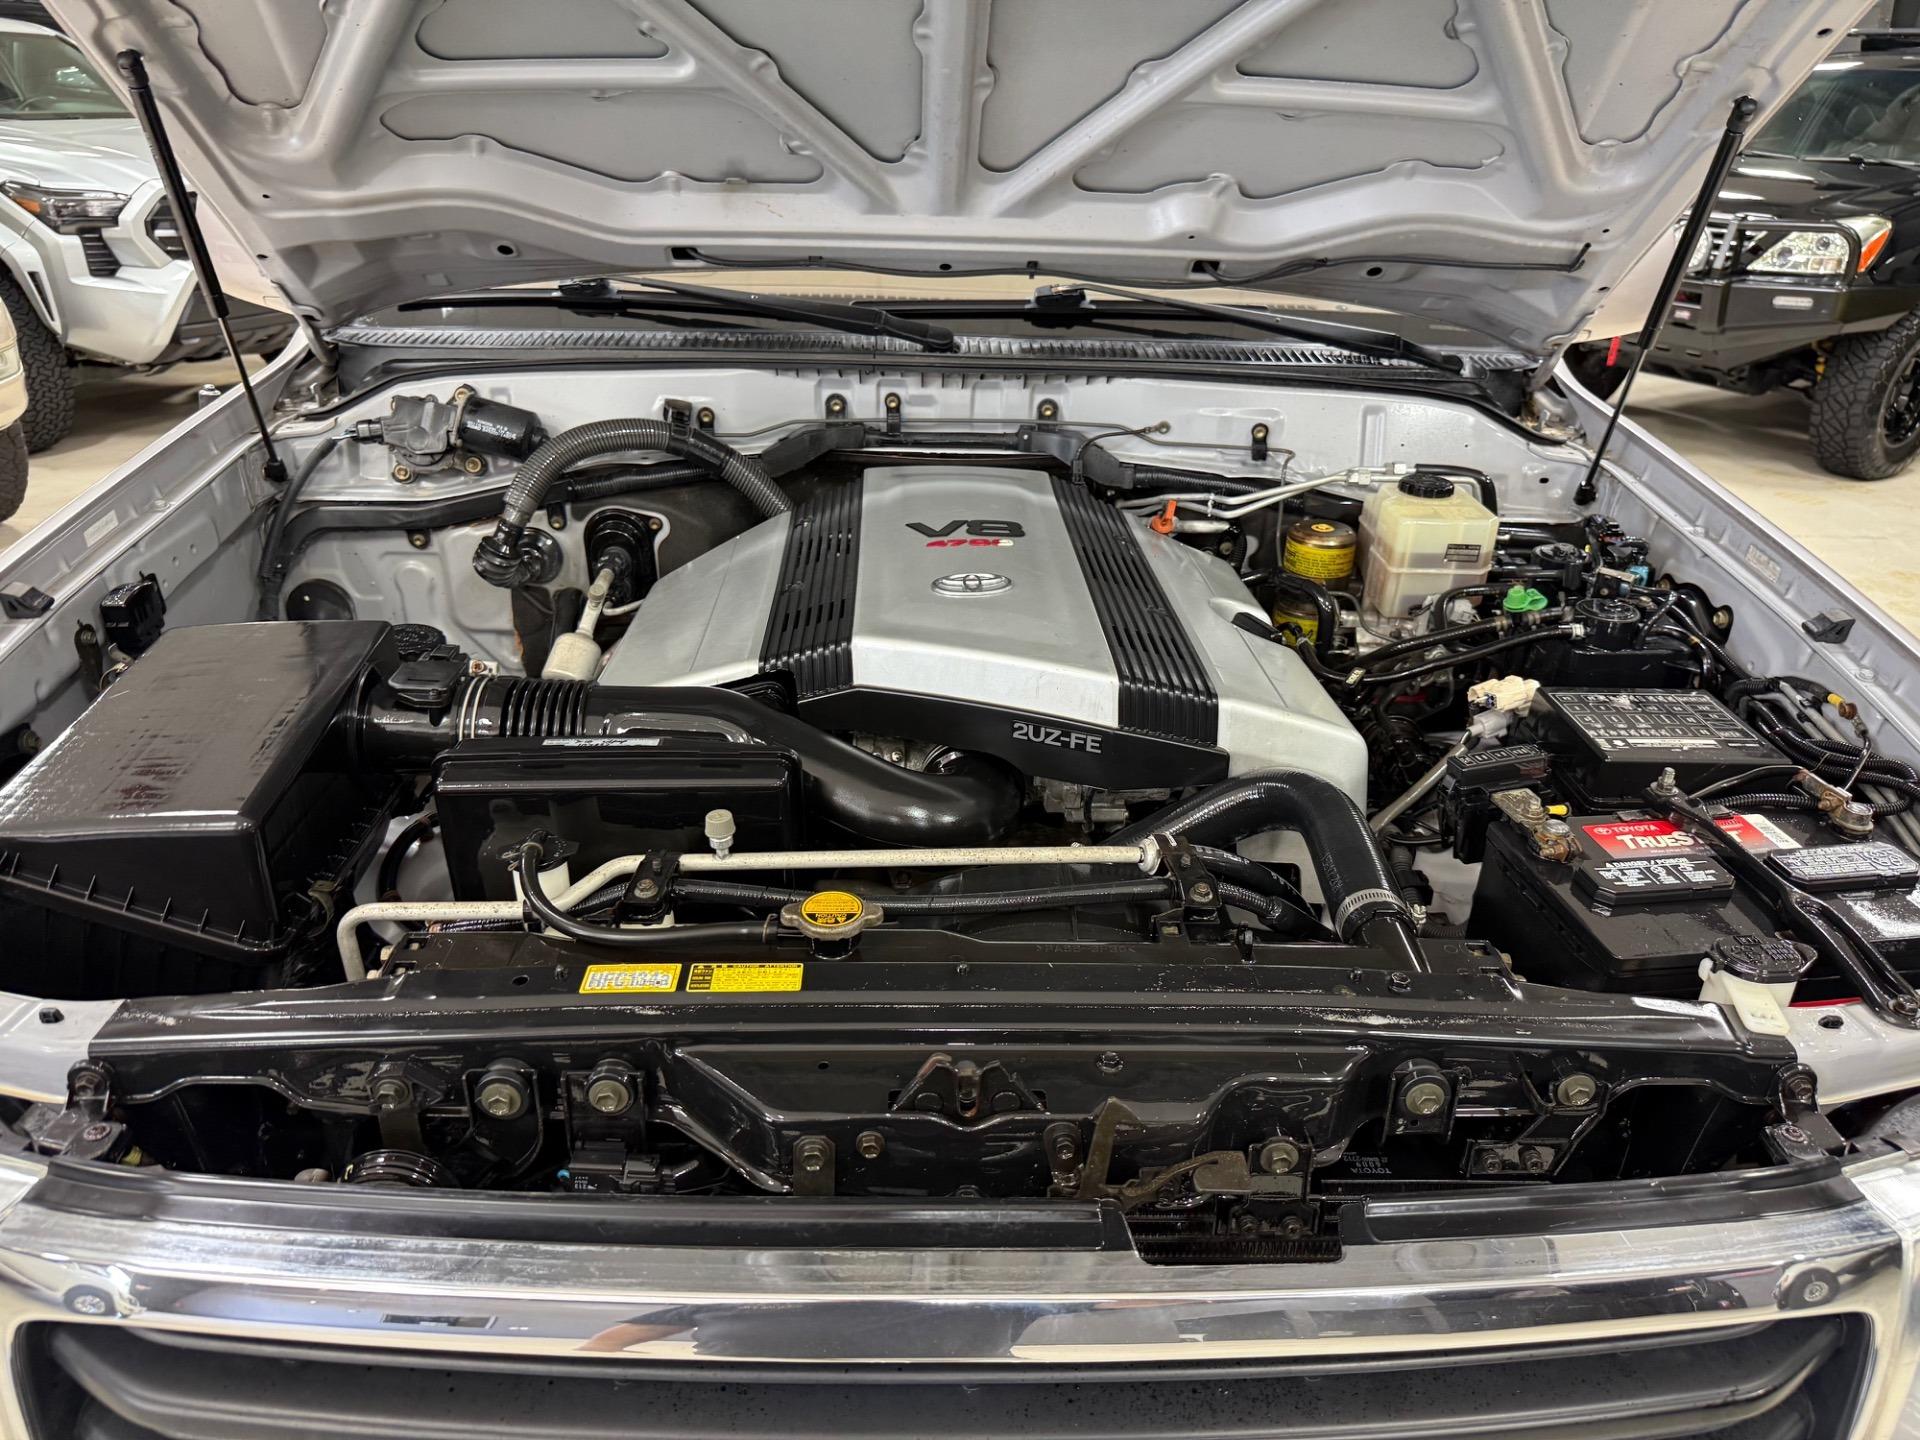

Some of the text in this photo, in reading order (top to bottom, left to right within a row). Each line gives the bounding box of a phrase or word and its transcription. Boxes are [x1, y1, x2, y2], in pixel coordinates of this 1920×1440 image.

[905, 519, 1026, 538] V8
[1012, 722, 1102, 754] 2UZ-FE
[1611, 824, 1660, 834] TOYOTA
